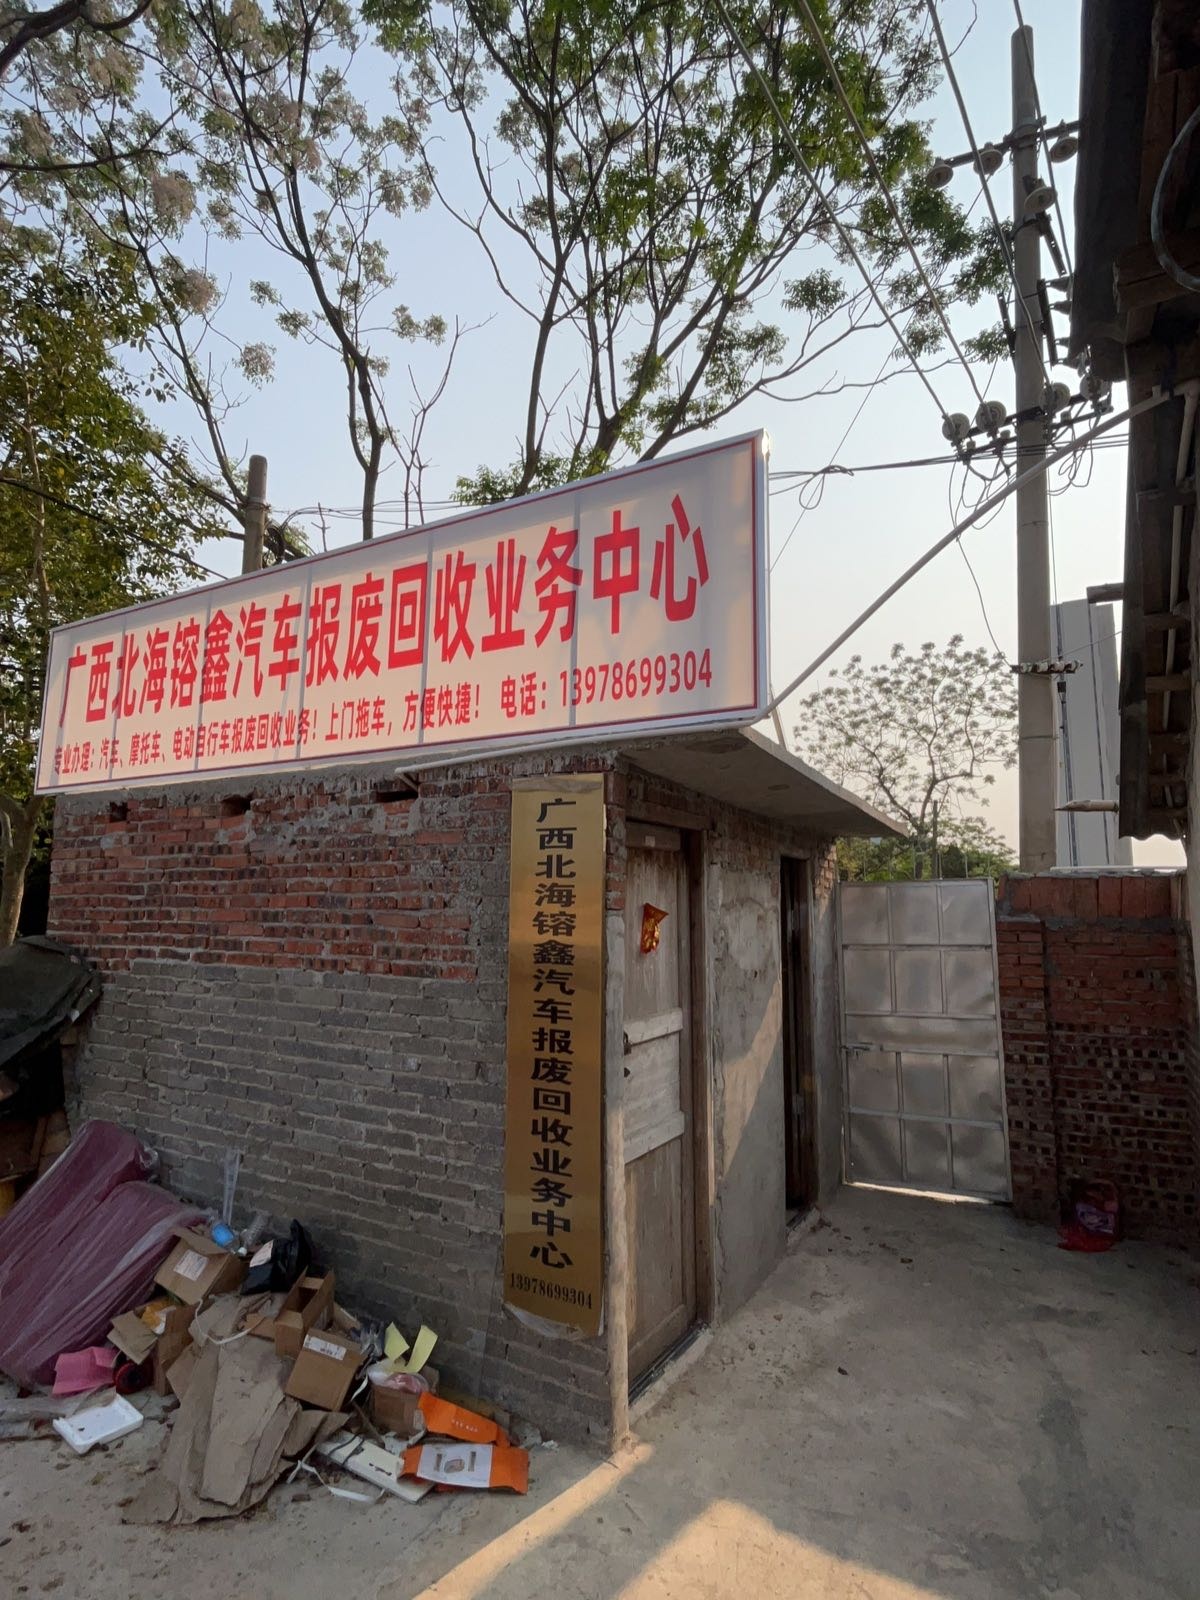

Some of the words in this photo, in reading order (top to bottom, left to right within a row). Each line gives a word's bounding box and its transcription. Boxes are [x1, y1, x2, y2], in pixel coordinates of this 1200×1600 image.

[59, 494, 710, 728] 广西北海镕鑫汽车报废回收业务中心
[530, 798, 578, 1269] 广西北海镕鑫汽车报废回收业务中心
[511, 1272, 592, 1309] 13978699304
